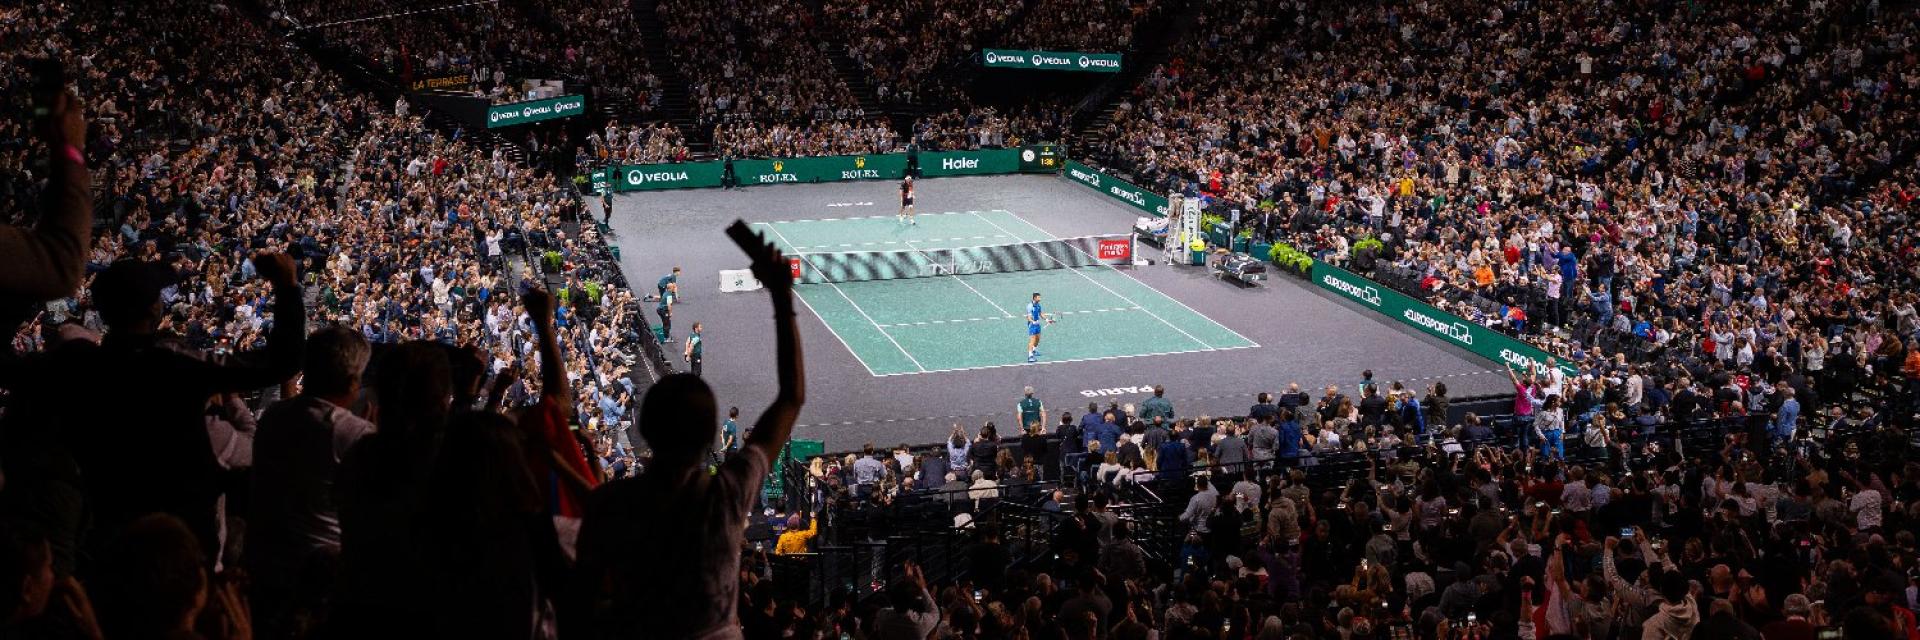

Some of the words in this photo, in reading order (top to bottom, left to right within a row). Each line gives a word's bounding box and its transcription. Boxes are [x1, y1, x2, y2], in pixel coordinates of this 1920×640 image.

[997, 55, 1025, 64] VEOLIA
[1043, 57, 1071, 65] VEOLIA
[1090, 59, 1119, 67] VEOLIA
[942, 157, 979, 170] Haier
[645, 172, 688, 182] VEOLIA
[760, 174, 798, 183] ROLEX
[841, 170, 880, 179] ROLEX
[1407, 309, 1450, 335] EUROSPORT
[1080, 385, 1155, 398] PARIS
